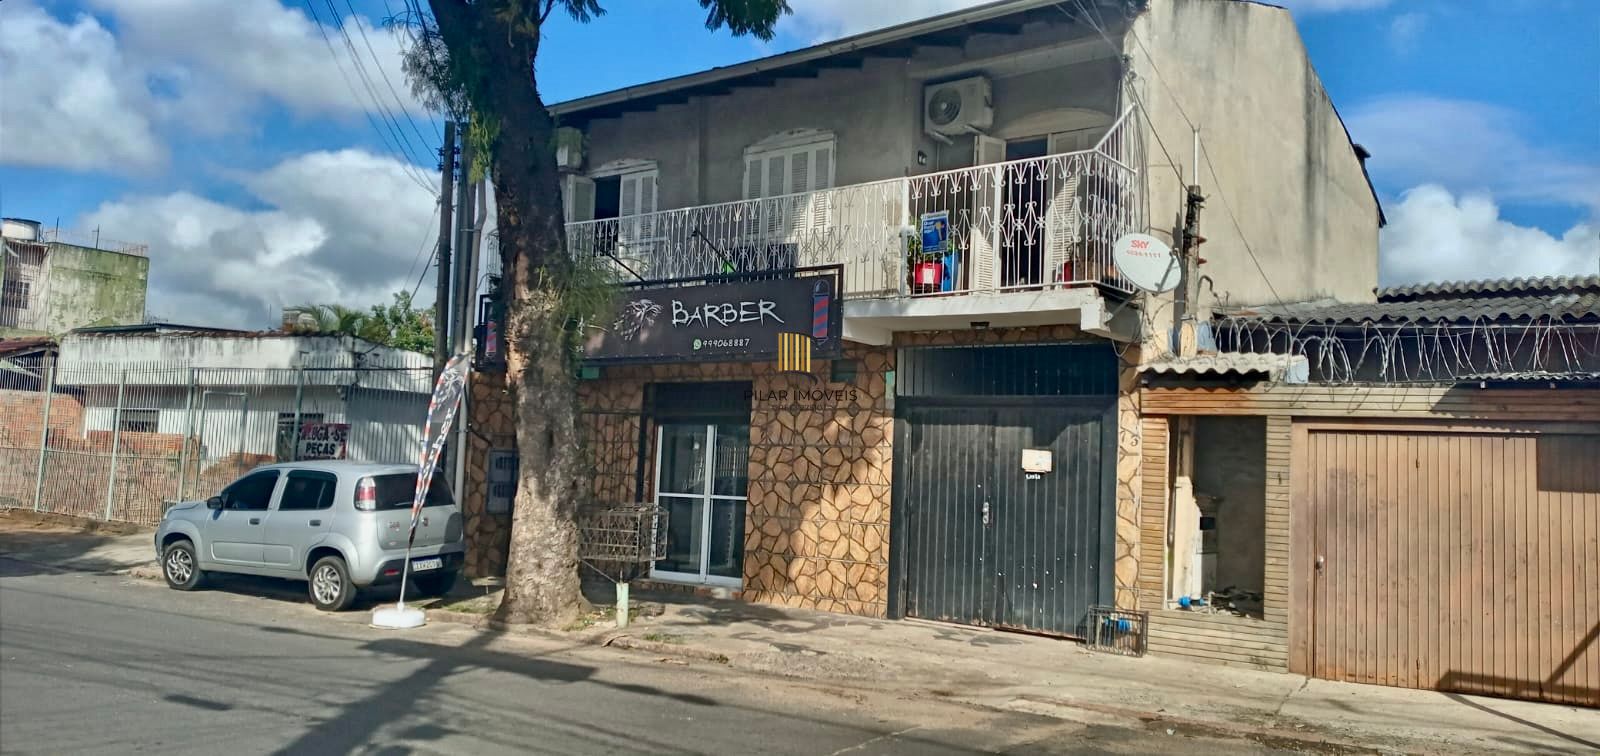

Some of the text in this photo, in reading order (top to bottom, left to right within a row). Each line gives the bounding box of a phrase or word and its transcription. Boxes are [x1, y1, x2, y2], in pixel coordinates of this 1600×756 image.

[1131, 239, 1149, 249] SKY
[702, 338, 750, 349] 999068887
[305, 441, 336, 455] PEÇAS
